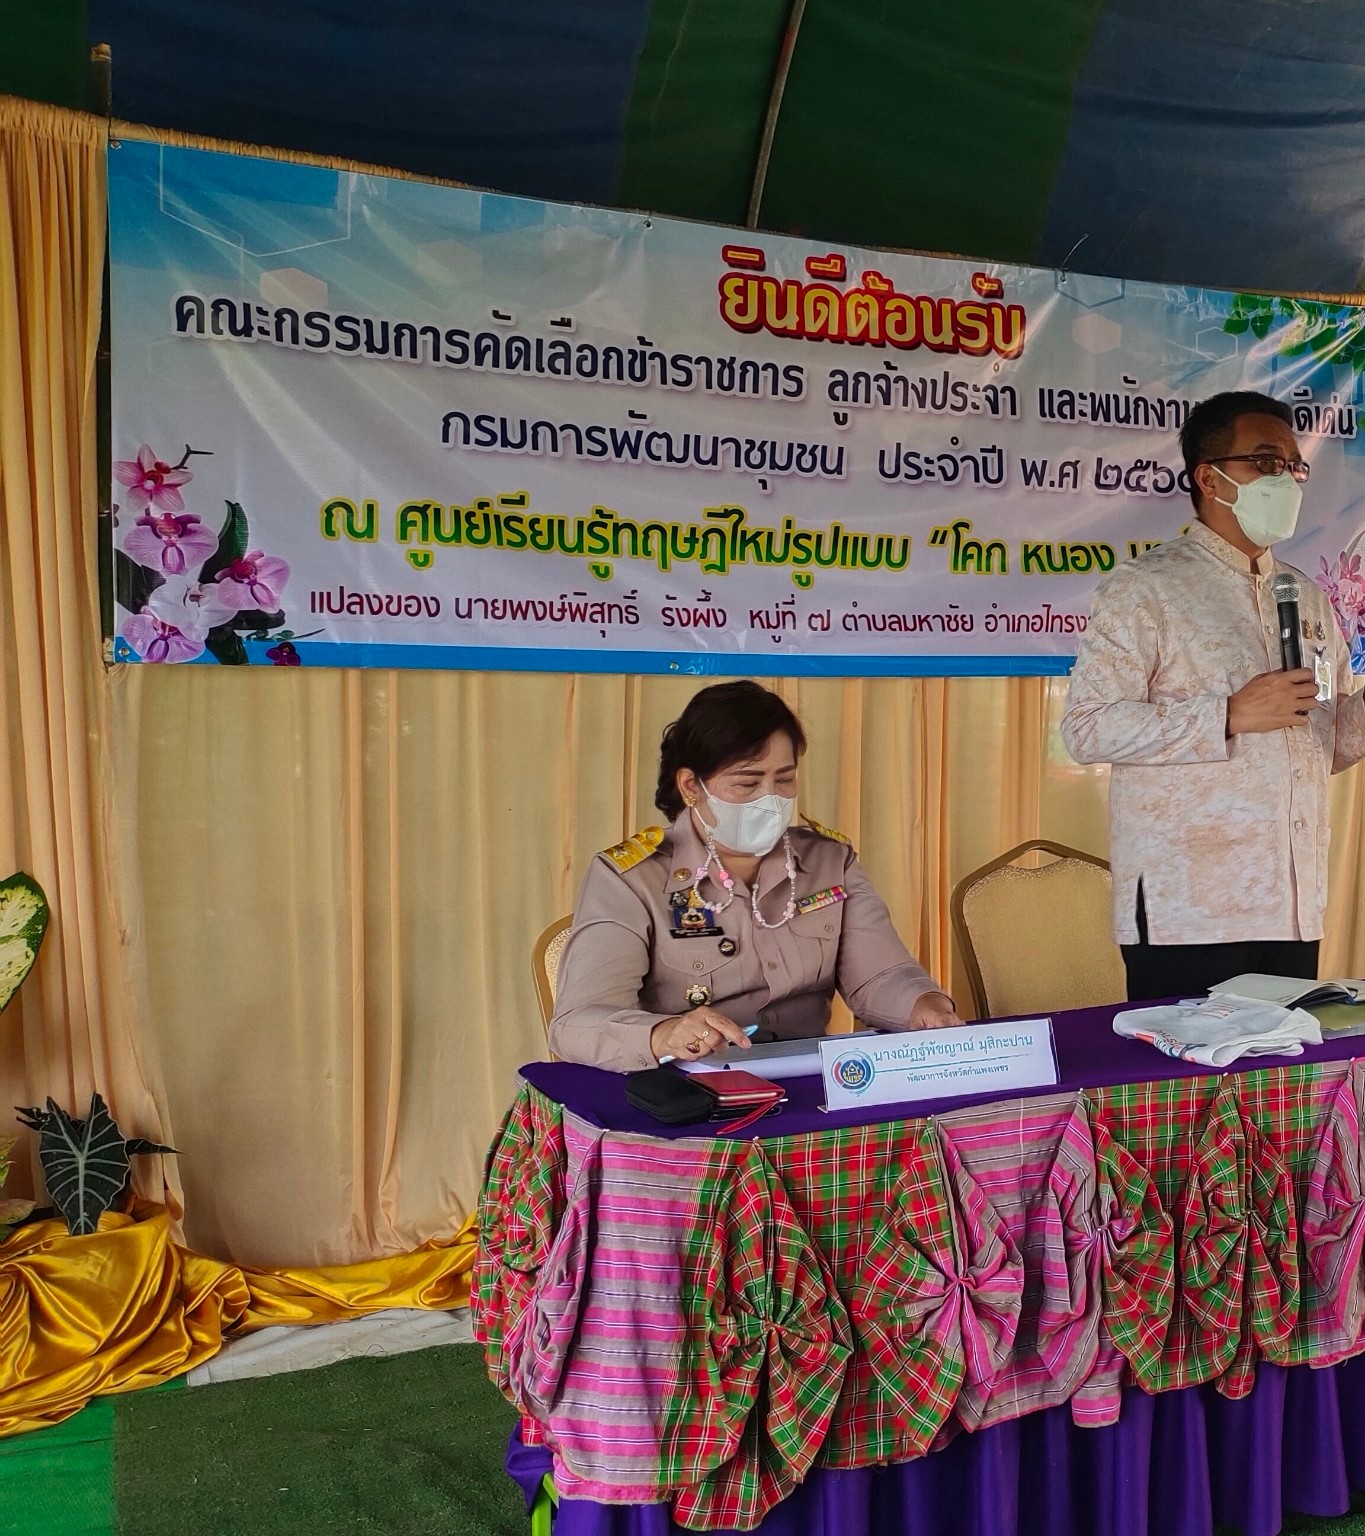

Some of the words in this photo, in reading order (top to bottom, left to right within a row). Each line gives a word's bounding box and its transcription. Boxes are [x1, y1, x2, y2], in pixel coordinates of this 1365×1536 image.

[720, 245, 1027, 359] ยินดีต้อนรับ
[174, 294, 804, 398] คณะกรรมการคัดเลือกข้าราชการ
[827, 360, 1018, 426] ลูกจ้างประจำ
[441, 409, 845, 491] กรมการพัฒนาชุมชน
[878, 436, 1003, 485] ประจำปี
[322, 499, 376, 541] ณ
[399, 494, 909, 588] ศูนย์เรียนรู้ทฤษฎีใหม่รูปแบบ
[1022, 543, 1116, 574] หนอง
[310, 585, 441, 618] แปลงของ
[454, 589, 640, 638] นายพงษ์พิสุทธิ์
[661, 589, 727, 628] รังผึ้ง
[749, 593, 797, 643] หมู่ที่
[807, 609, 831, 632] ๗
[842, 600, 974, 633] ตำบลมหาชัย
[979, 1033, 1034, 1054] มุสิกะปาน
